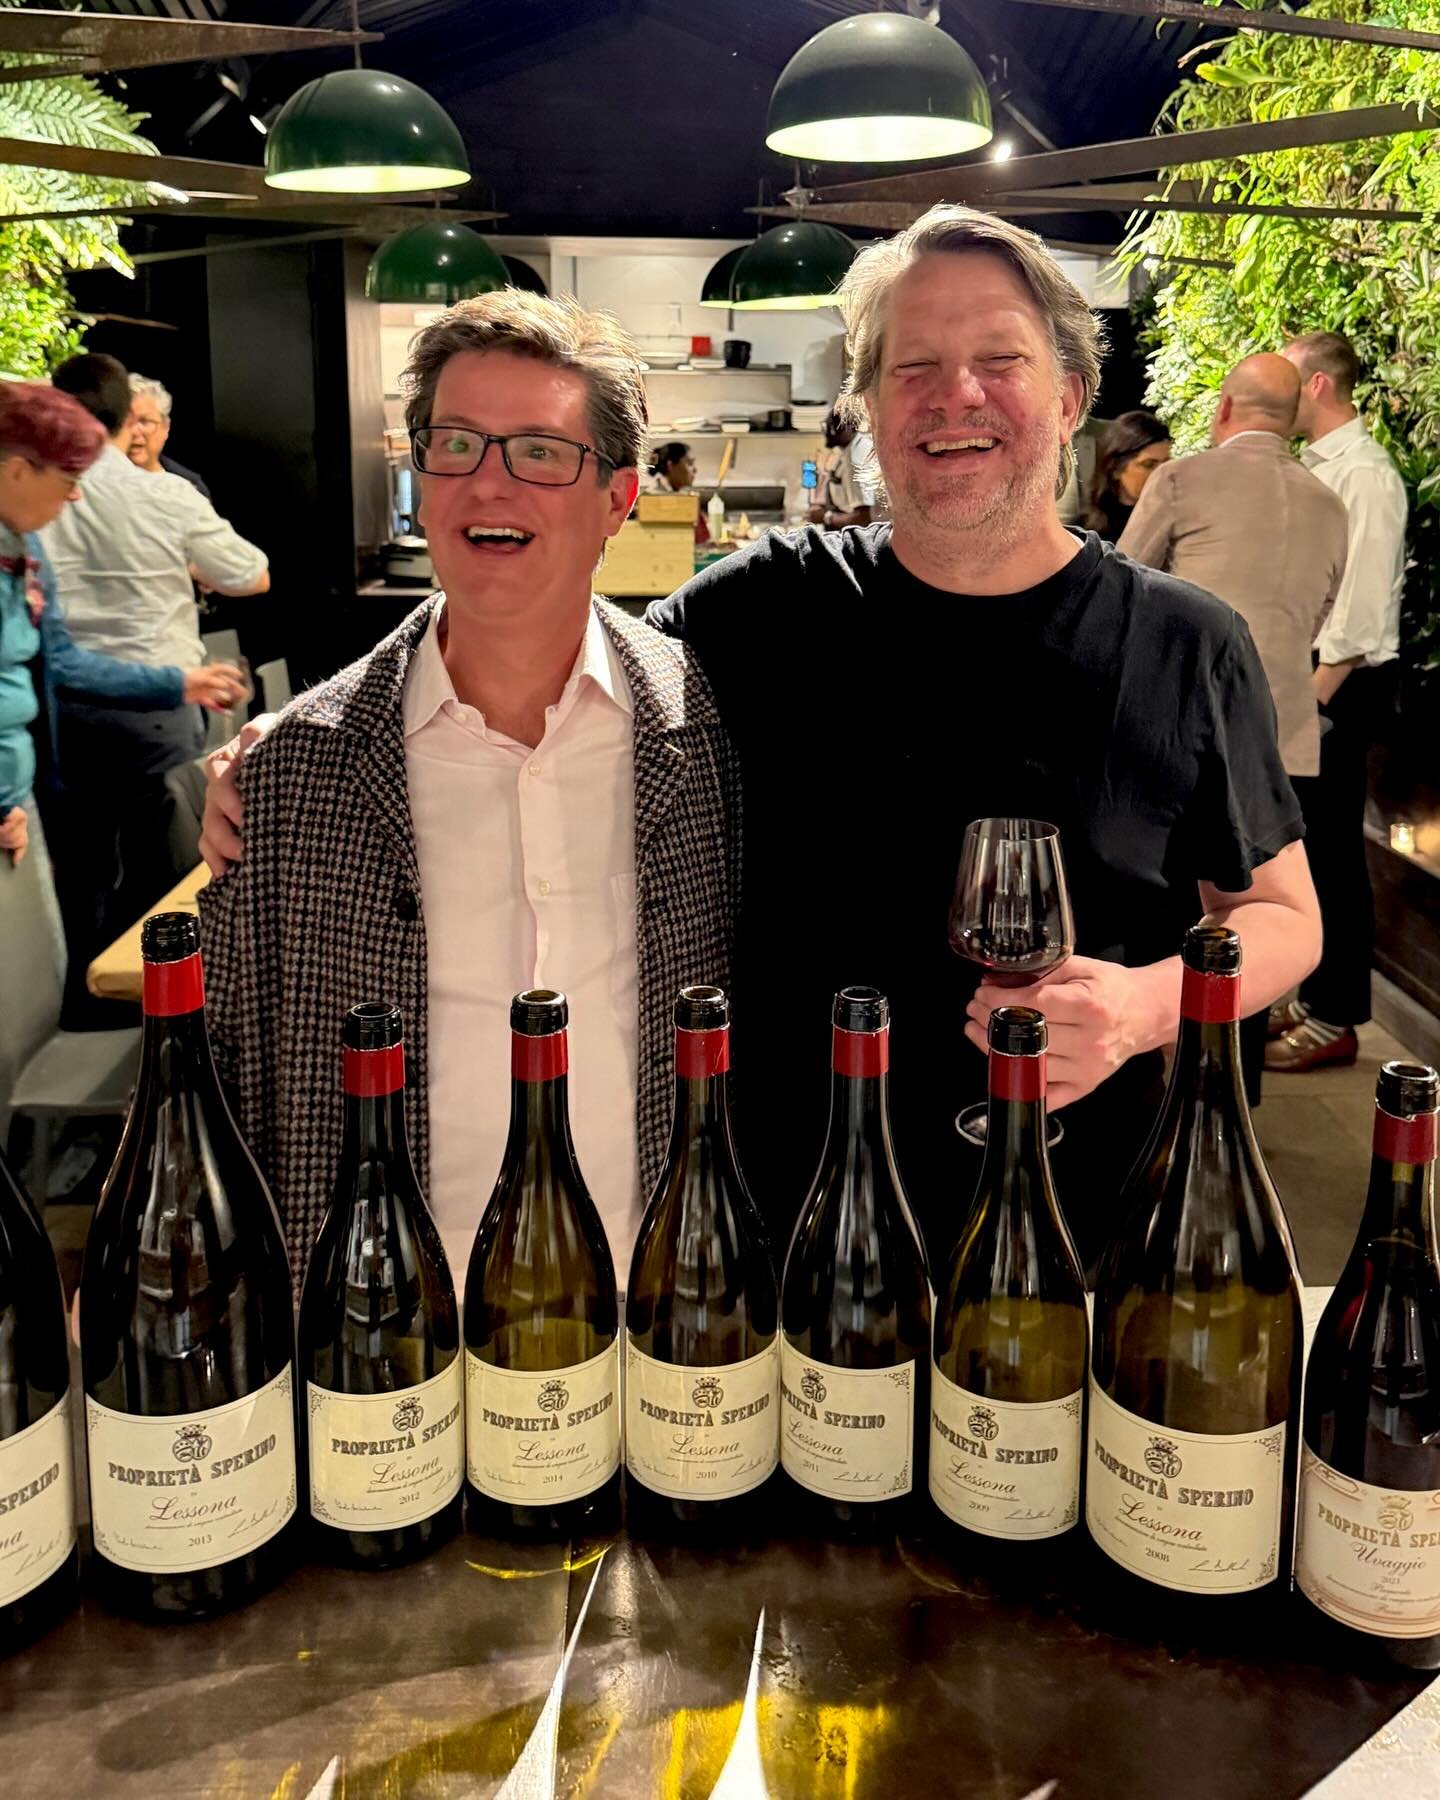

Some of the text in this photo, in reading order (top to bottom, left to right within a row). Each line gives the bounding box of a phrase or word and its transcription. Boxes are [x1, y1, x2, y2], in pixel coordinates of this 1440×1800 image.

[482, 1408, 560, 1432] PROPRIETÀ
[639, 1393, 770, 1427] PROPRIETÀ SPERINO
[824, 1410, 885, 1429] SPERINO
[331, 1432, 416, 1455] PROPRIETÀ
[670, 1433, 740, 1455] Lessona
[789, 1414, 844, 1455] Lessona
[108, 1434, 276, 1487] PROPRIETÀ SPERINO
[515, 1440, 586, 1461] Lessona
[995, 1447, 1058, 1465] SPERINO
[370, 1456, 440, 1485] Lessona
[695, 1470, 717, 1479] 2010
[948, 1454, 1017, 1493] Lessona
[1094, 1438, 1254, 1508] PROPRIETÀ SPERINO
[150, 1495, 238, 1521] Lessona
[399, 1491, 421, 1505] 2012
[1119, 1493, 1203, 1541] Lessona
[1318, 1503, 1440, 1548] PROPRIETÀ SPE
[188, 1534, 213, 1547] 2013
[1350, 1542, 1427, 1576] Uvaggio
